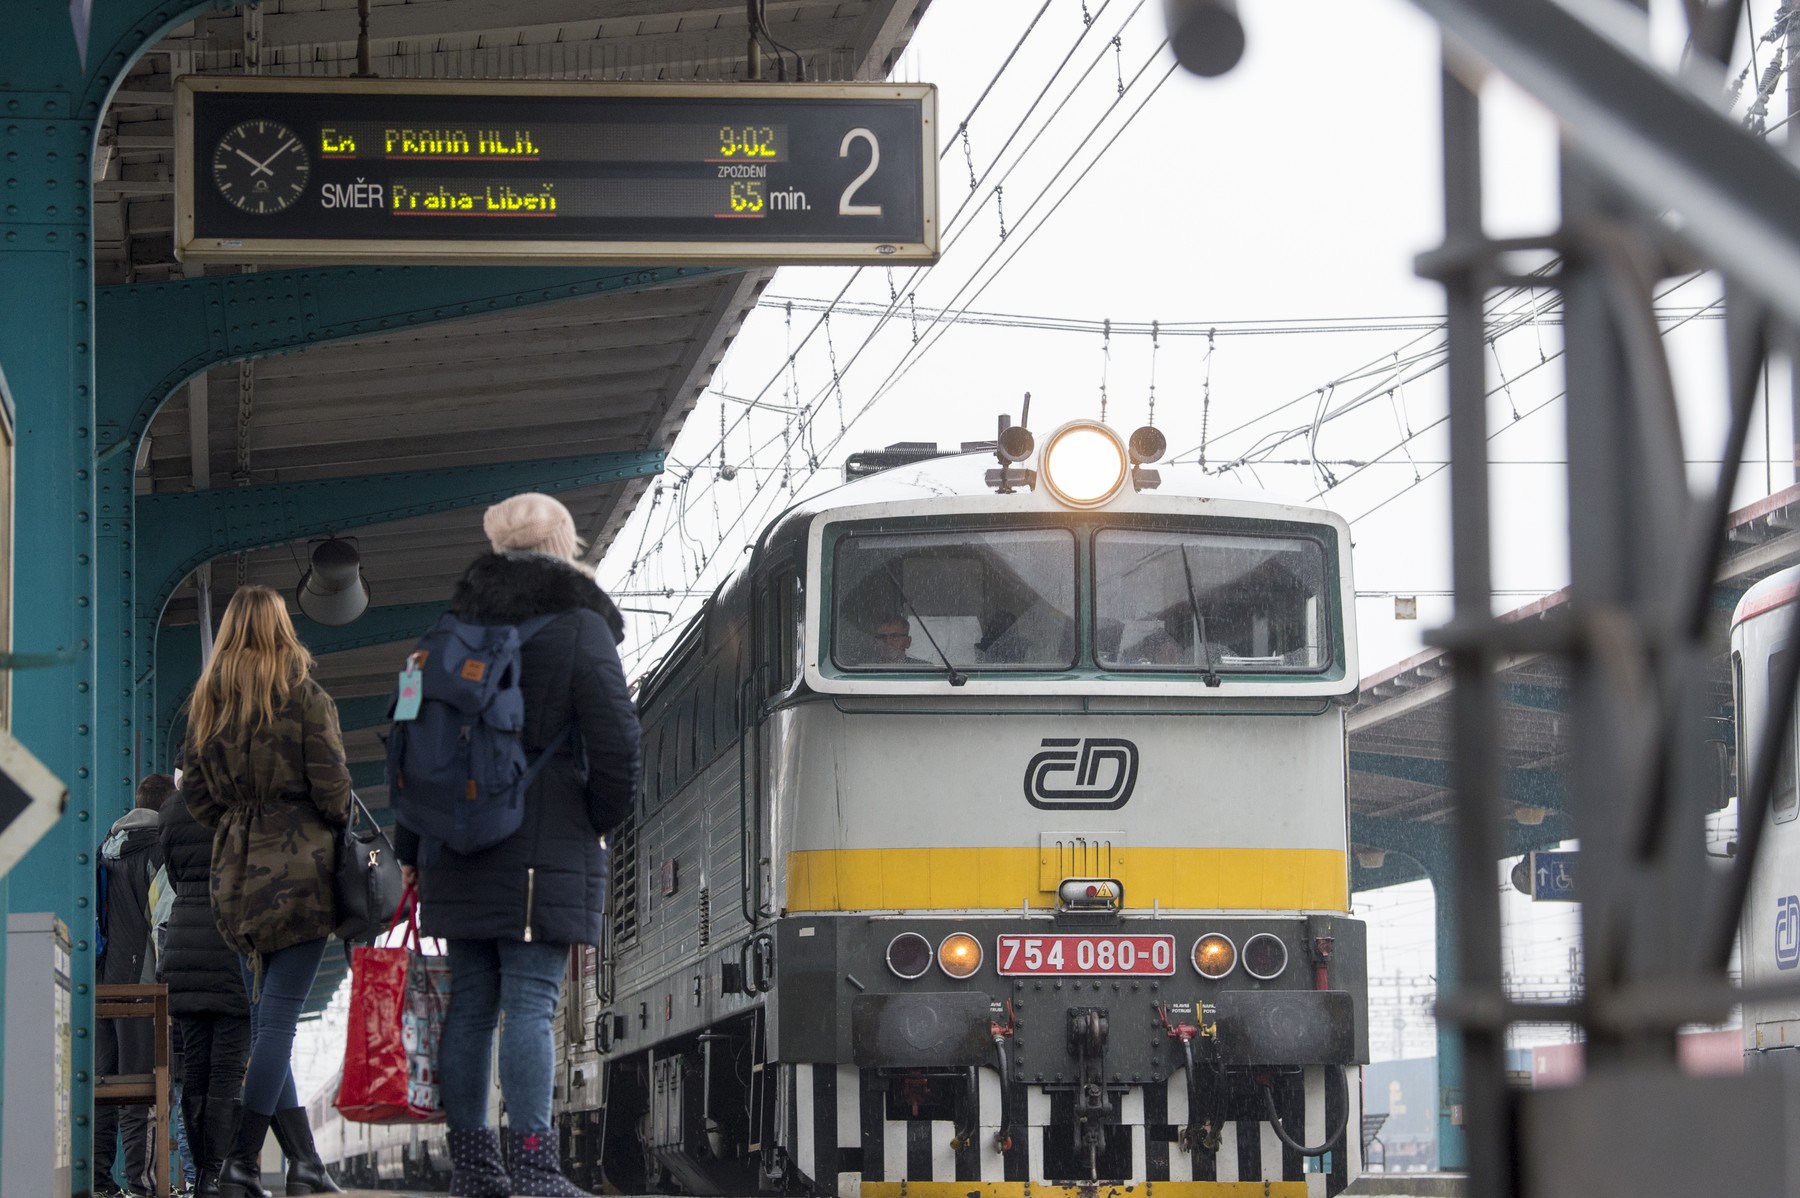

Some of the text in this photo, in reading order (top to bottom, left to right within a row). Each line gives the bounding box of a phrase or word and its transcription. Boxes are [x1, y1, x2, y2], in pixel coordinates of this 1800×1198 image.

[321, 128, 355, 153] Ex
[385, 129, 469, 154] PRAHA
[719, 126, 776, 156] 9:02
[717, 164, 767, 179] ZPOŽDĚNÍ
[838, 127, 882, 216] 2
[320, 177, 557, 211] SMĚR Praha-Libeň
[730, 181, 812, 212] 65 min.
[1023, 737, 1139, 811] ČD
[1002, 939, 1170, 971] 754 080-0
